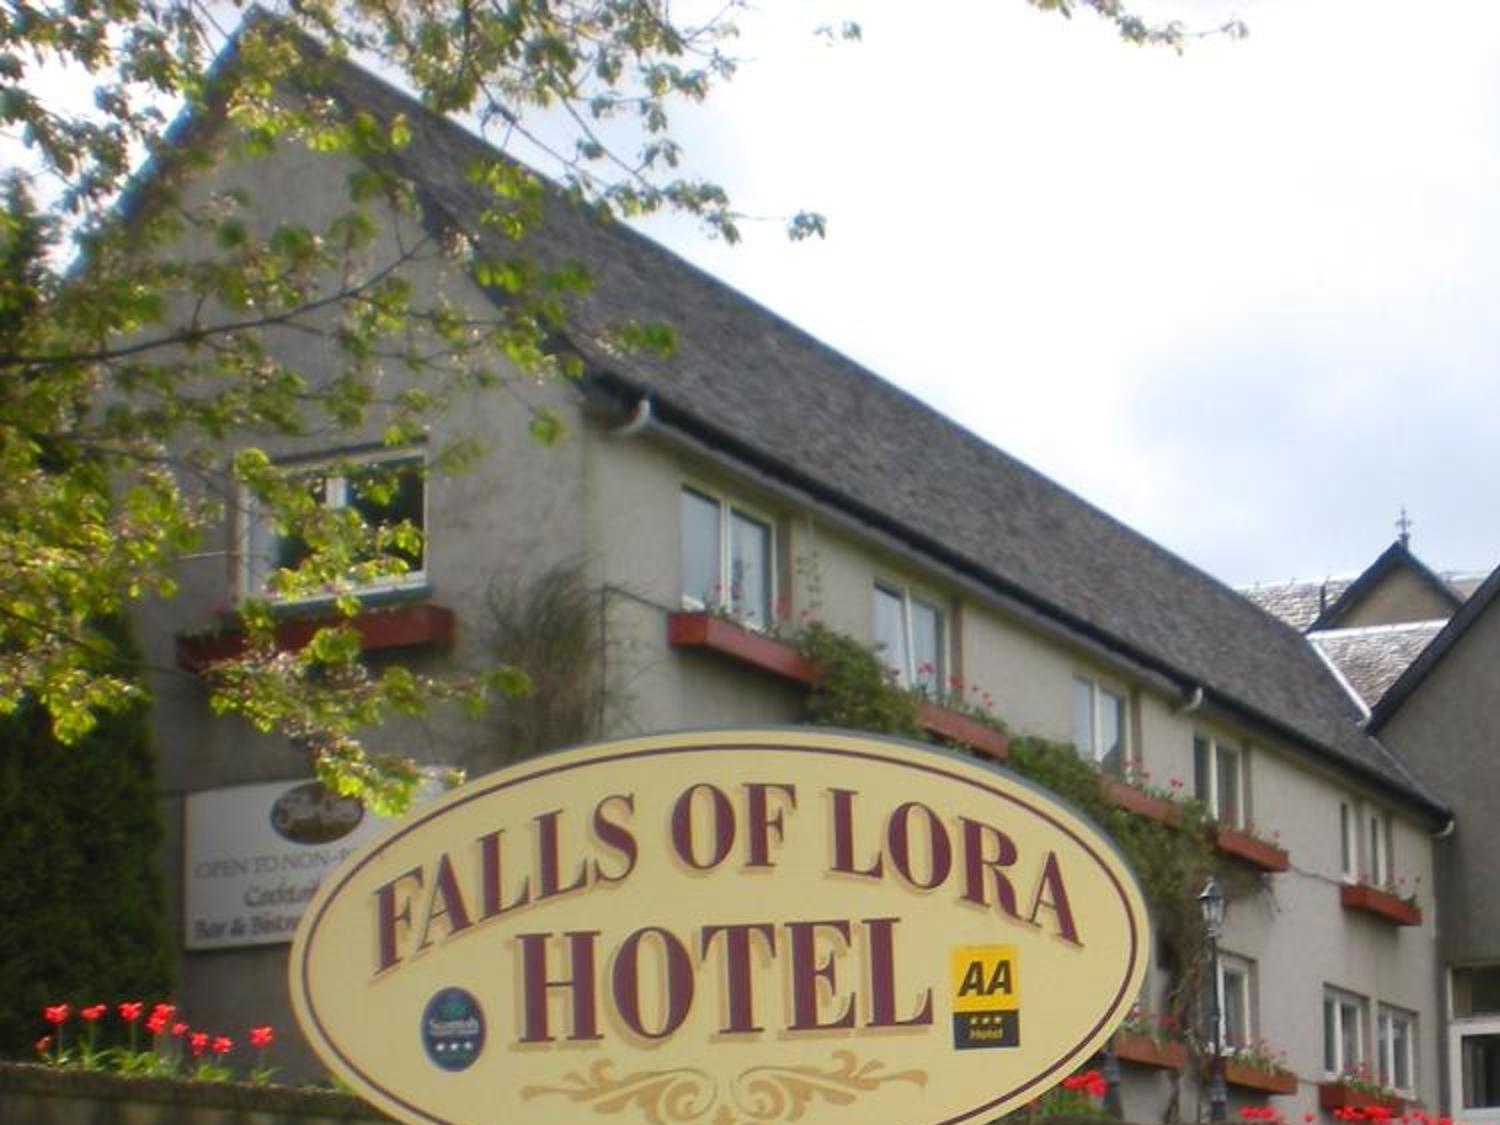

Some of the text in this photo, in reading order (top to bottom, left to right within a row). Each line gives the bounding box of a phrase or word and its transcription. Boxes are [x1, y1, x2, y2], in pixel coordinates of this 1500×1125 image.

[371, 782, 1084, 976] FALLS OF LORA
[515, 917, 934, 1042] HOTEL
[957, 960, 1012, 997] AA
